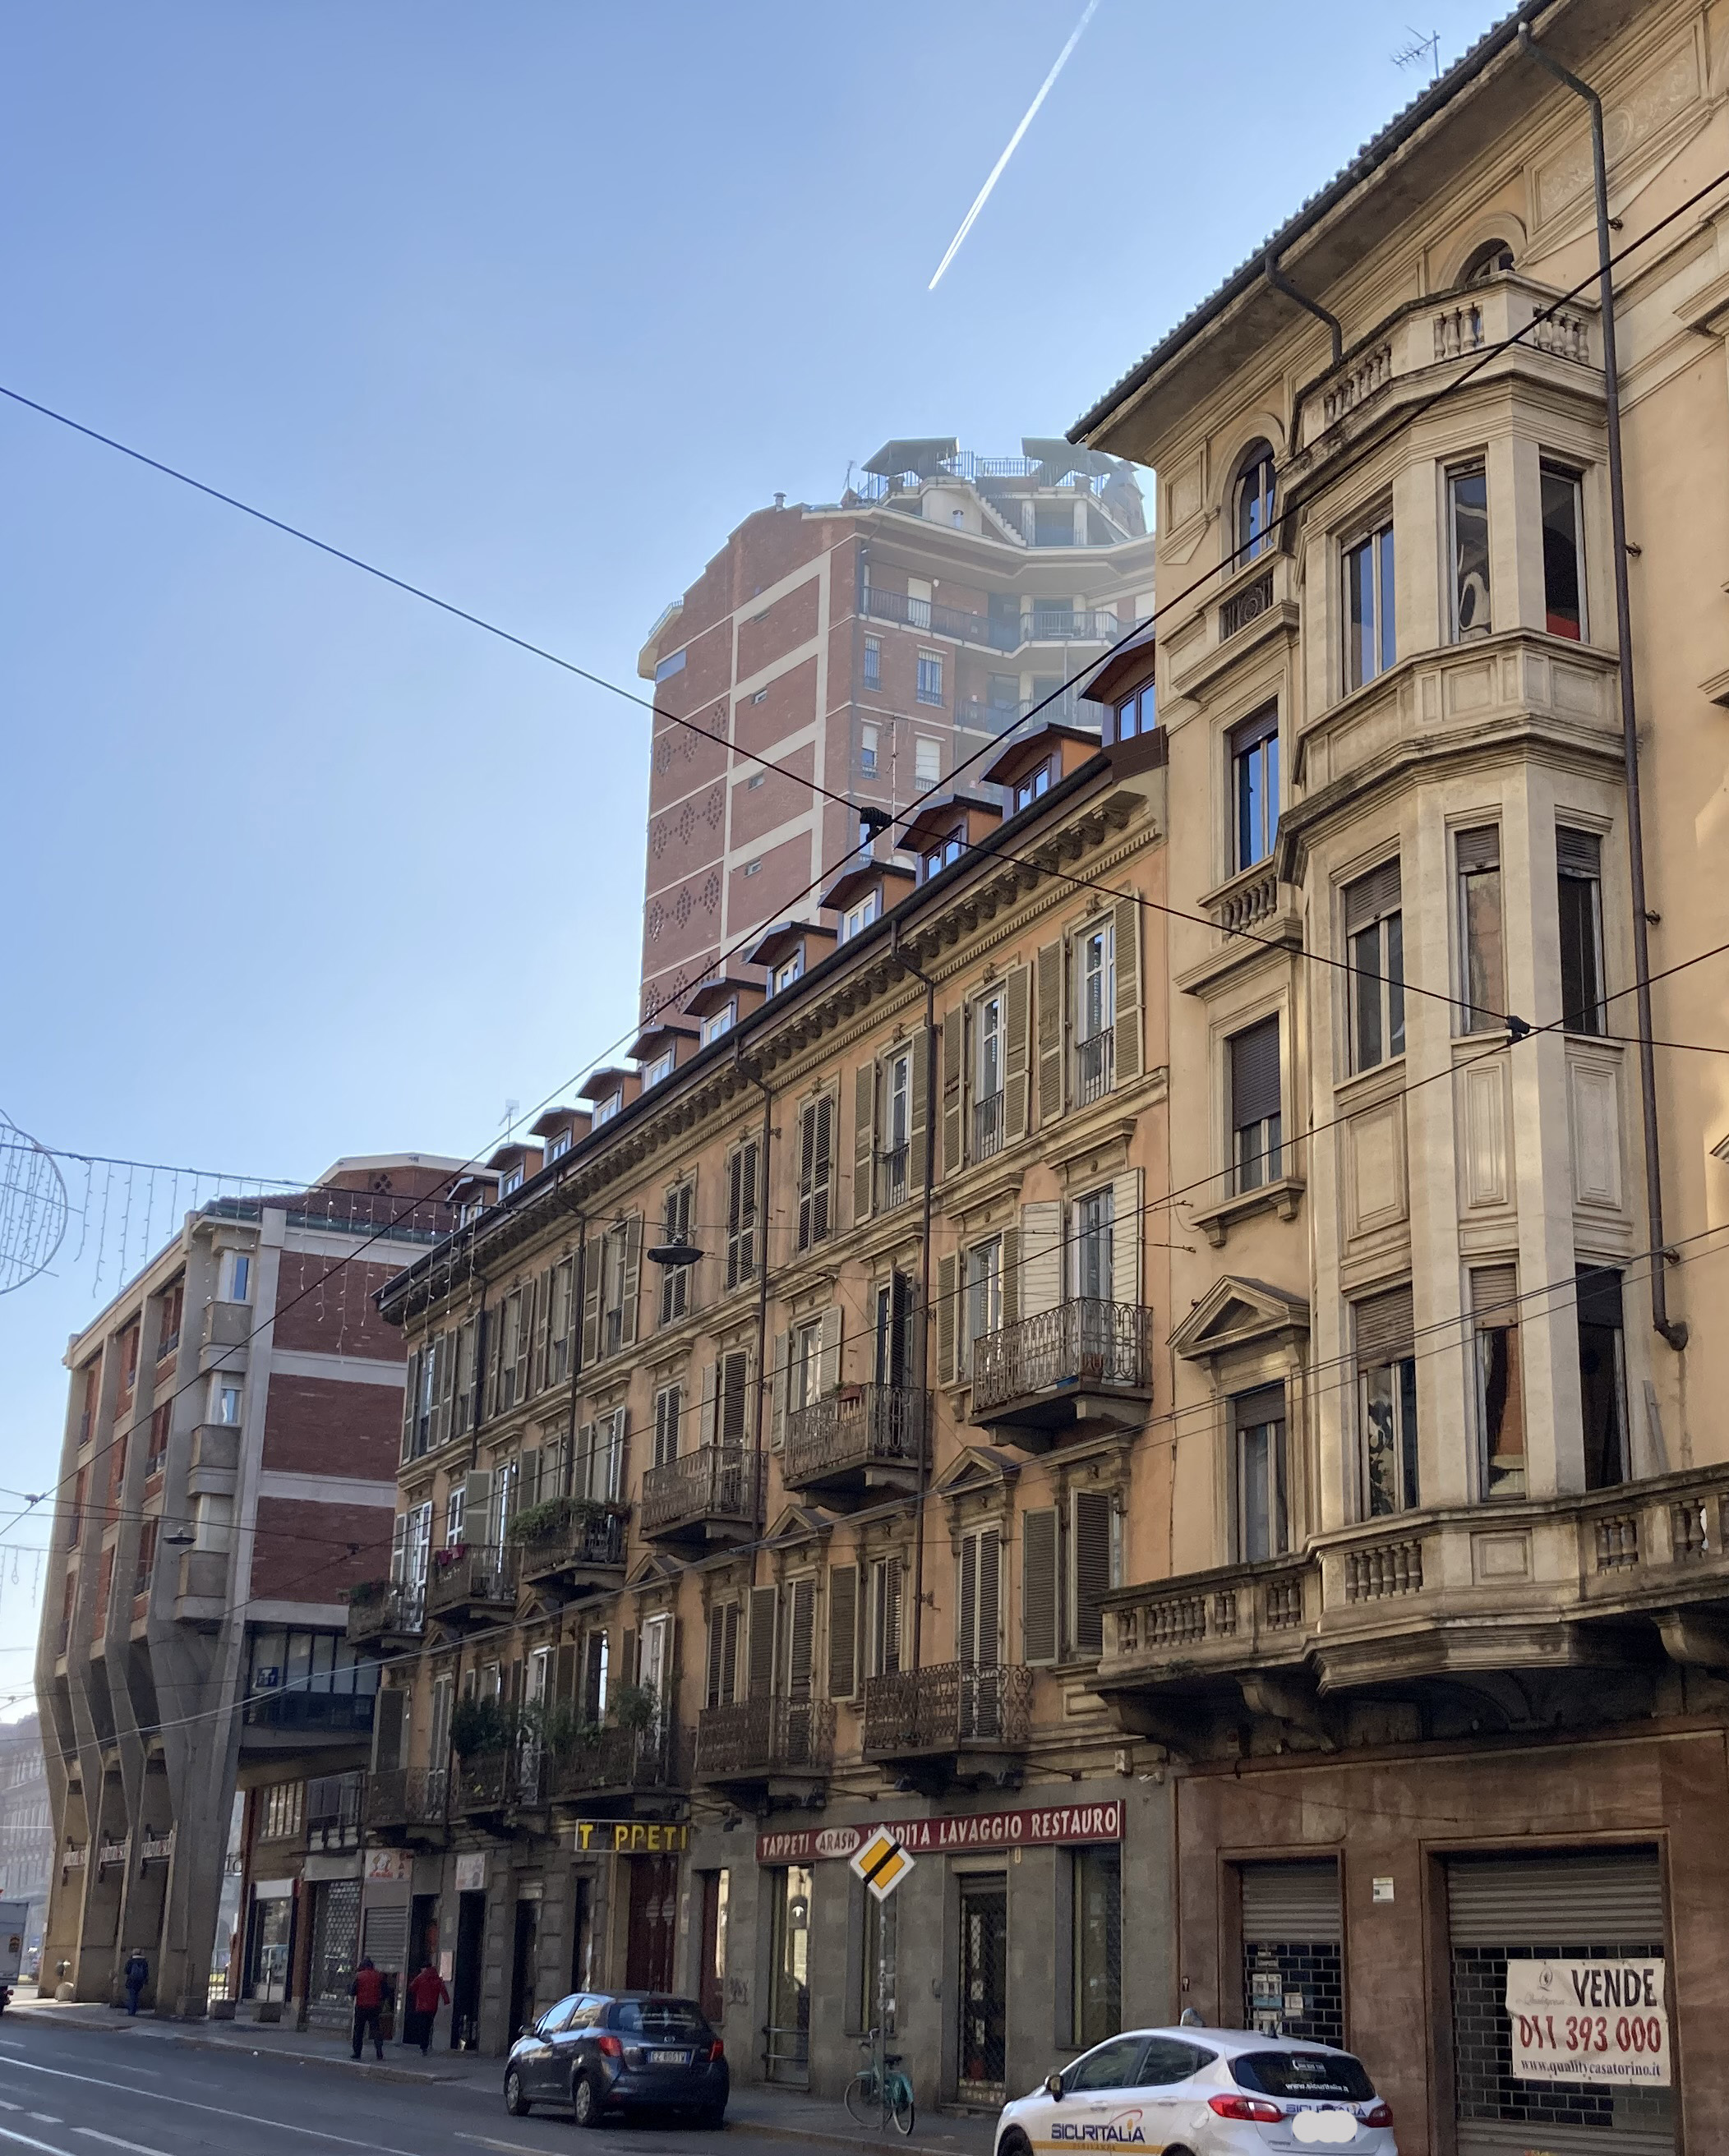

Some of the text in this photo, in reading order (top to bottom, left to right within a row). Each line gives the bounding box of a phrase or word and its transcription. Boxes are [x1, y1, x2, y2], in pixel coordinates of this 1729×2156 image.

[763, 1833, 809, 1856] TAPPETI
[820, 1832, 855, 1850] ARASH
[938, 1815, 1022, 1845] LAVAGGIO
[1031, 1807, 1117, 1838] RESTAURO
[1571, 1969, 1657, 2007] VENDE
[1520, 2015, 1661, 2052] 011 393 000
[1521, 2059, 1660, 2077] www.qualitycasatorino.it
[1051, 2121, 1146, 2143] SICURITALIA
